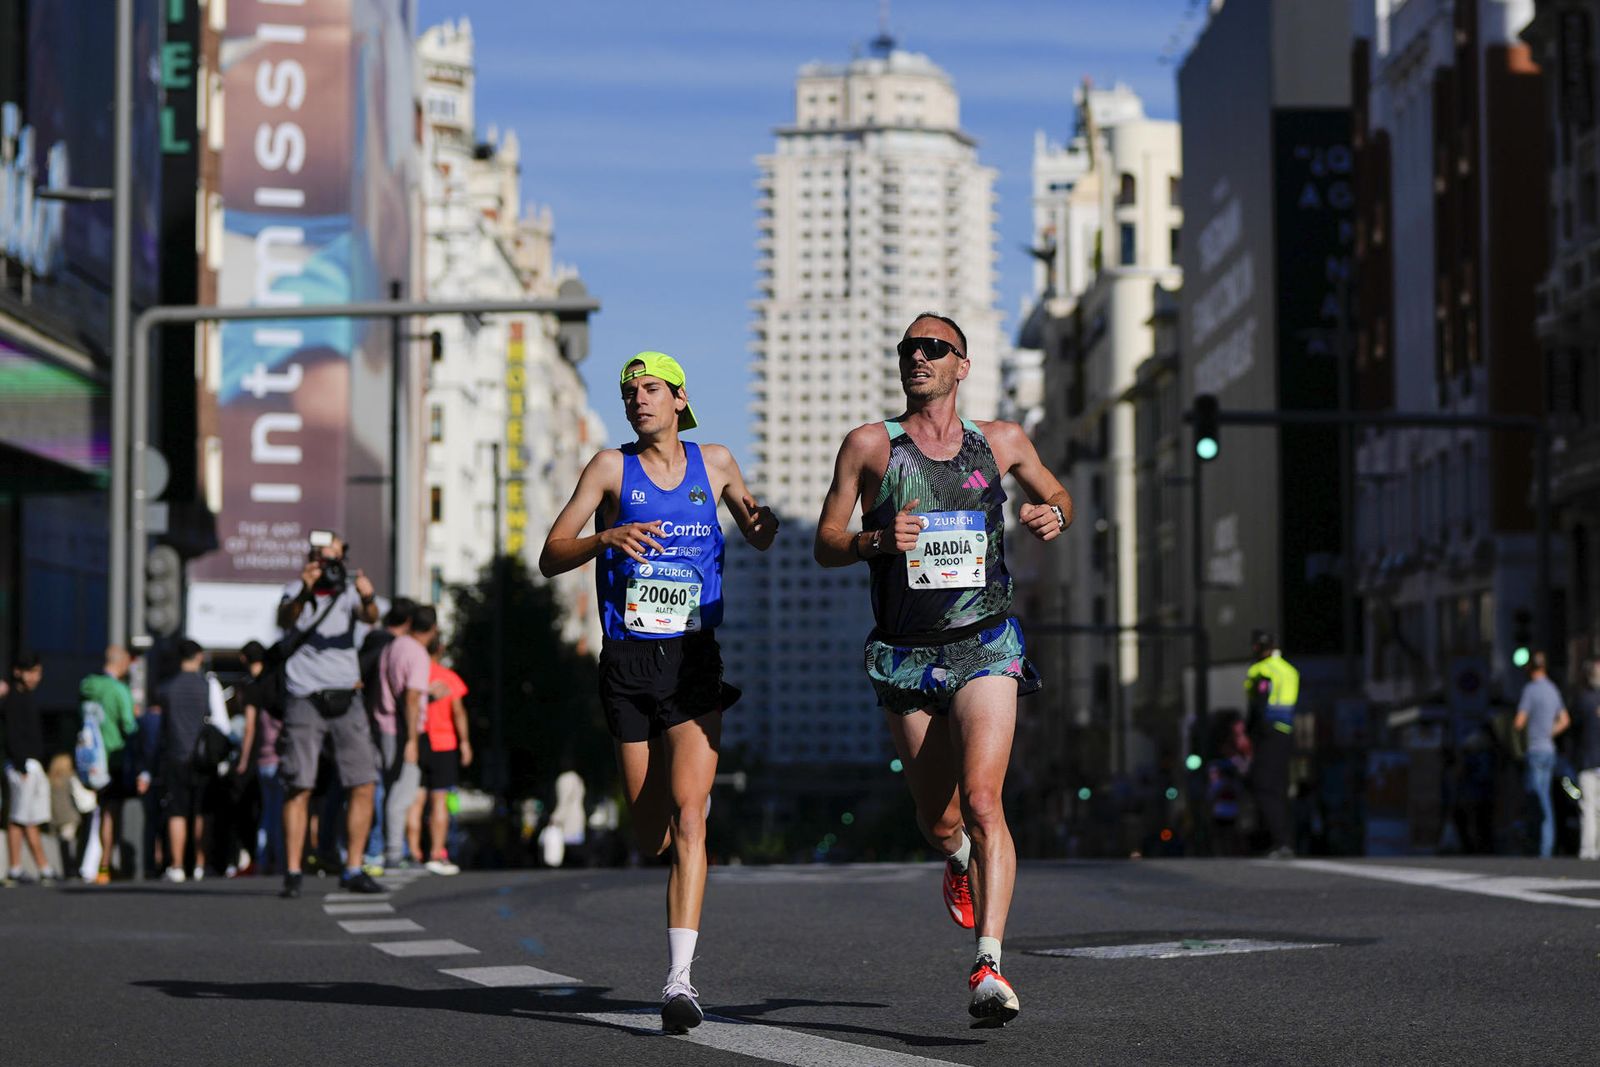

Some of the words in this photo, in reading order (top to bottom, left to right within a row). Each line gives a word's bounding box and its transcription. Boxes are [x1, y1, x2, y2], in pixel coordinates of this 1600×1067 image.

[934, 516, 973, 526] ZURICH
[924, 536, 972, 556] ABADÍA
[934, 557, 963, 566] 20001
[657, 567, 693, 578] ZURICH
[639, 585, 687, 606] 20060
